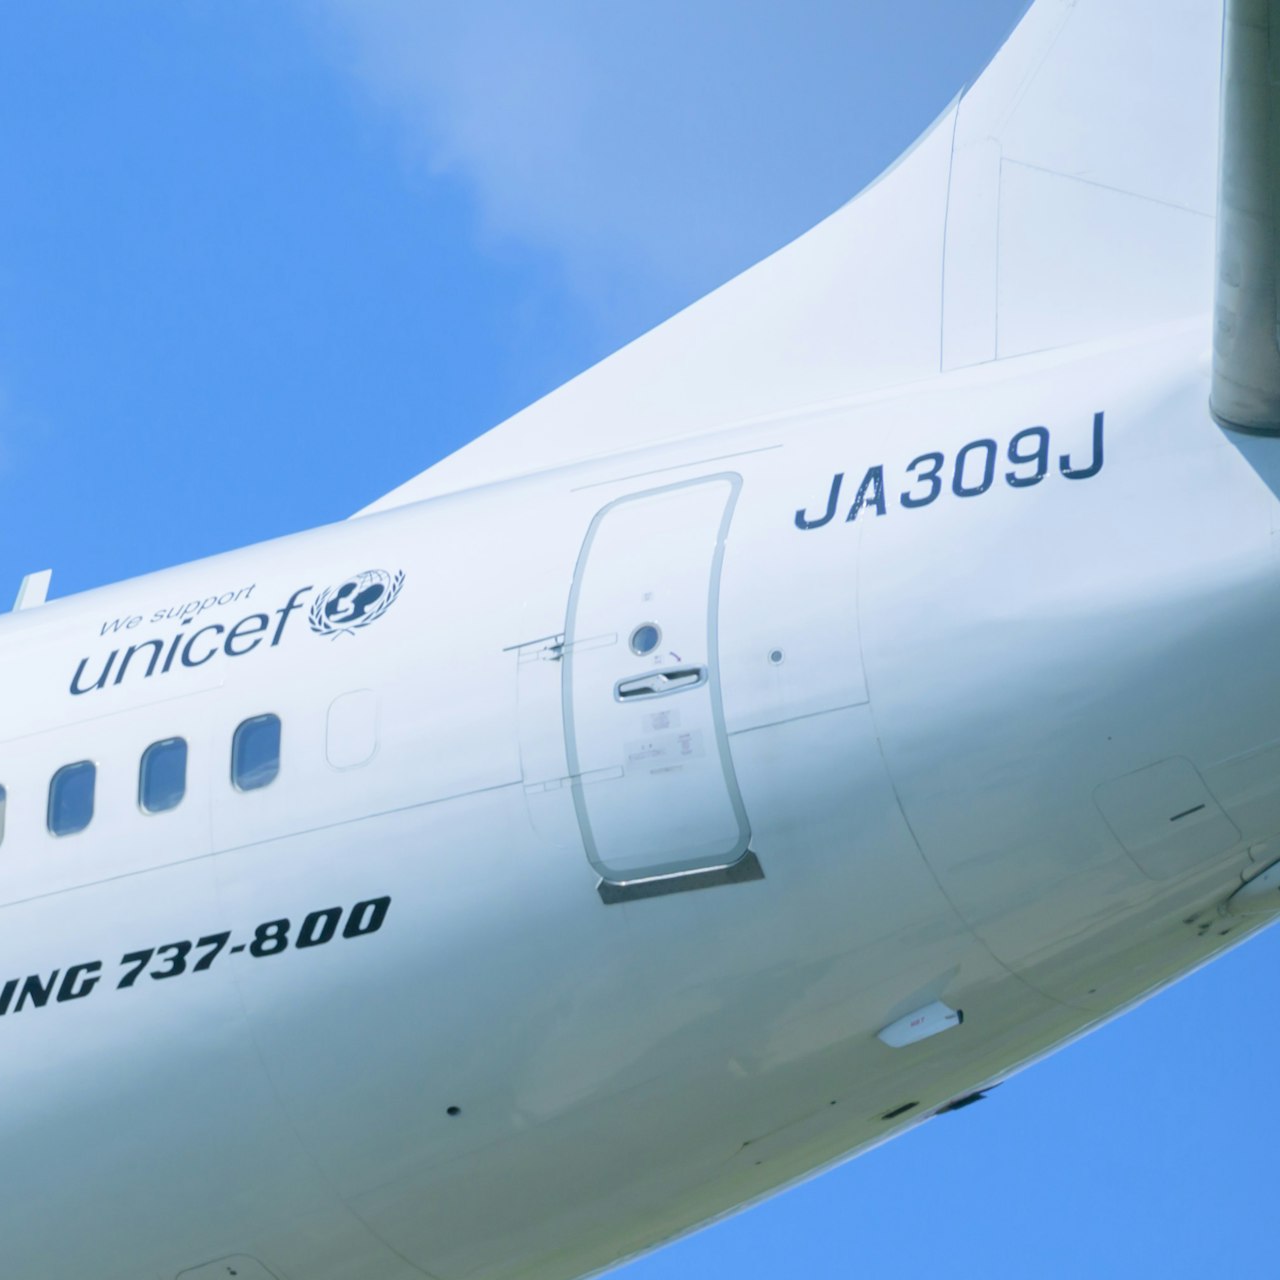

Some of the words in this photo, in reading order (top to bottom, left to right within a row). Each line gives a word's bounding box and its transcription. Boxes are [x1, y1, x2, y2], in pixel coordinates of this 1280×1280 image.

[794, 411, 1104, 530] JA309J
[69, 585, 314, 696] unicef
[99, 615, 144, 637] We
[150, 583, 256, 625] support
[116, 895, 392, 989] 737-800
